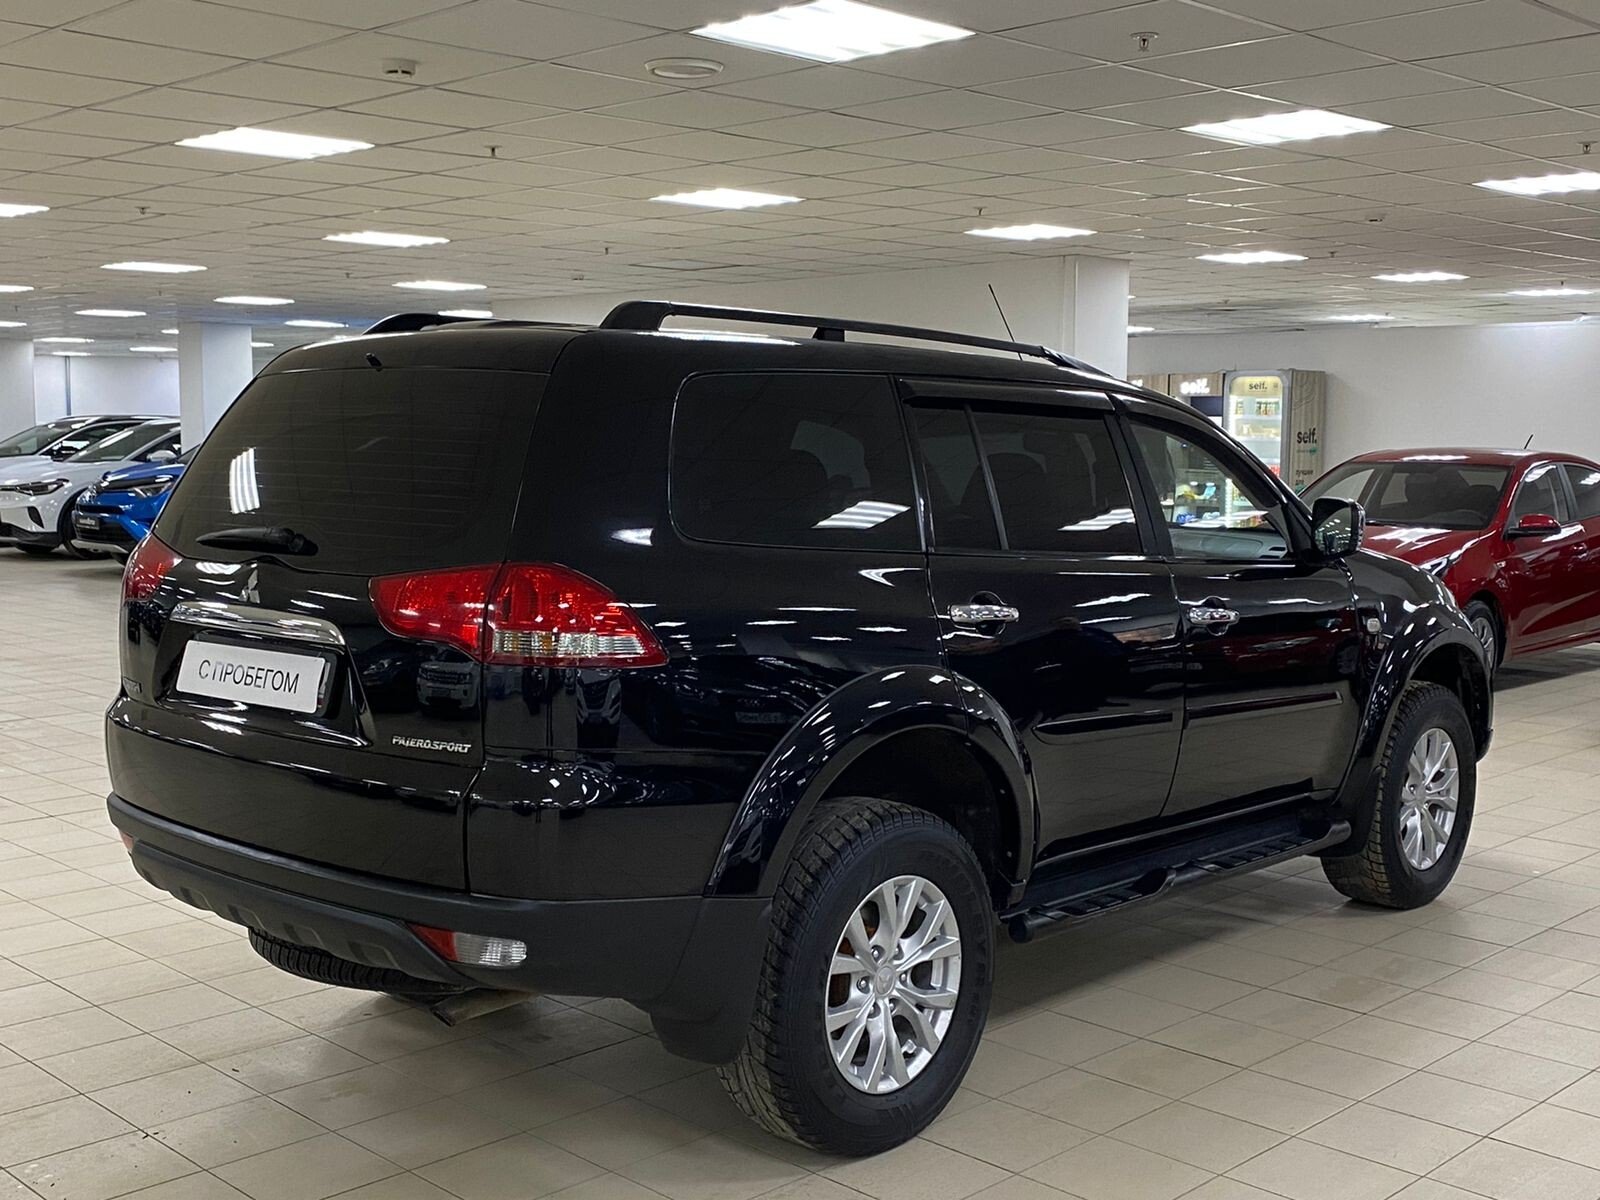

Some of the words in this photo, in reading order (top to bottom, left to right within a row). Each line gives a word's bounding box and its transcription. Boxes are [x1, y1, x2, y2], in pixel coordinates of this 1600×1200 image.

[1249, 382, 1267, 390] self.
[1296, 428, 1317, 444] self.
[198, 659, 211, 680] С
[211, 660, 300, 694] ПРОБЕГОМ
